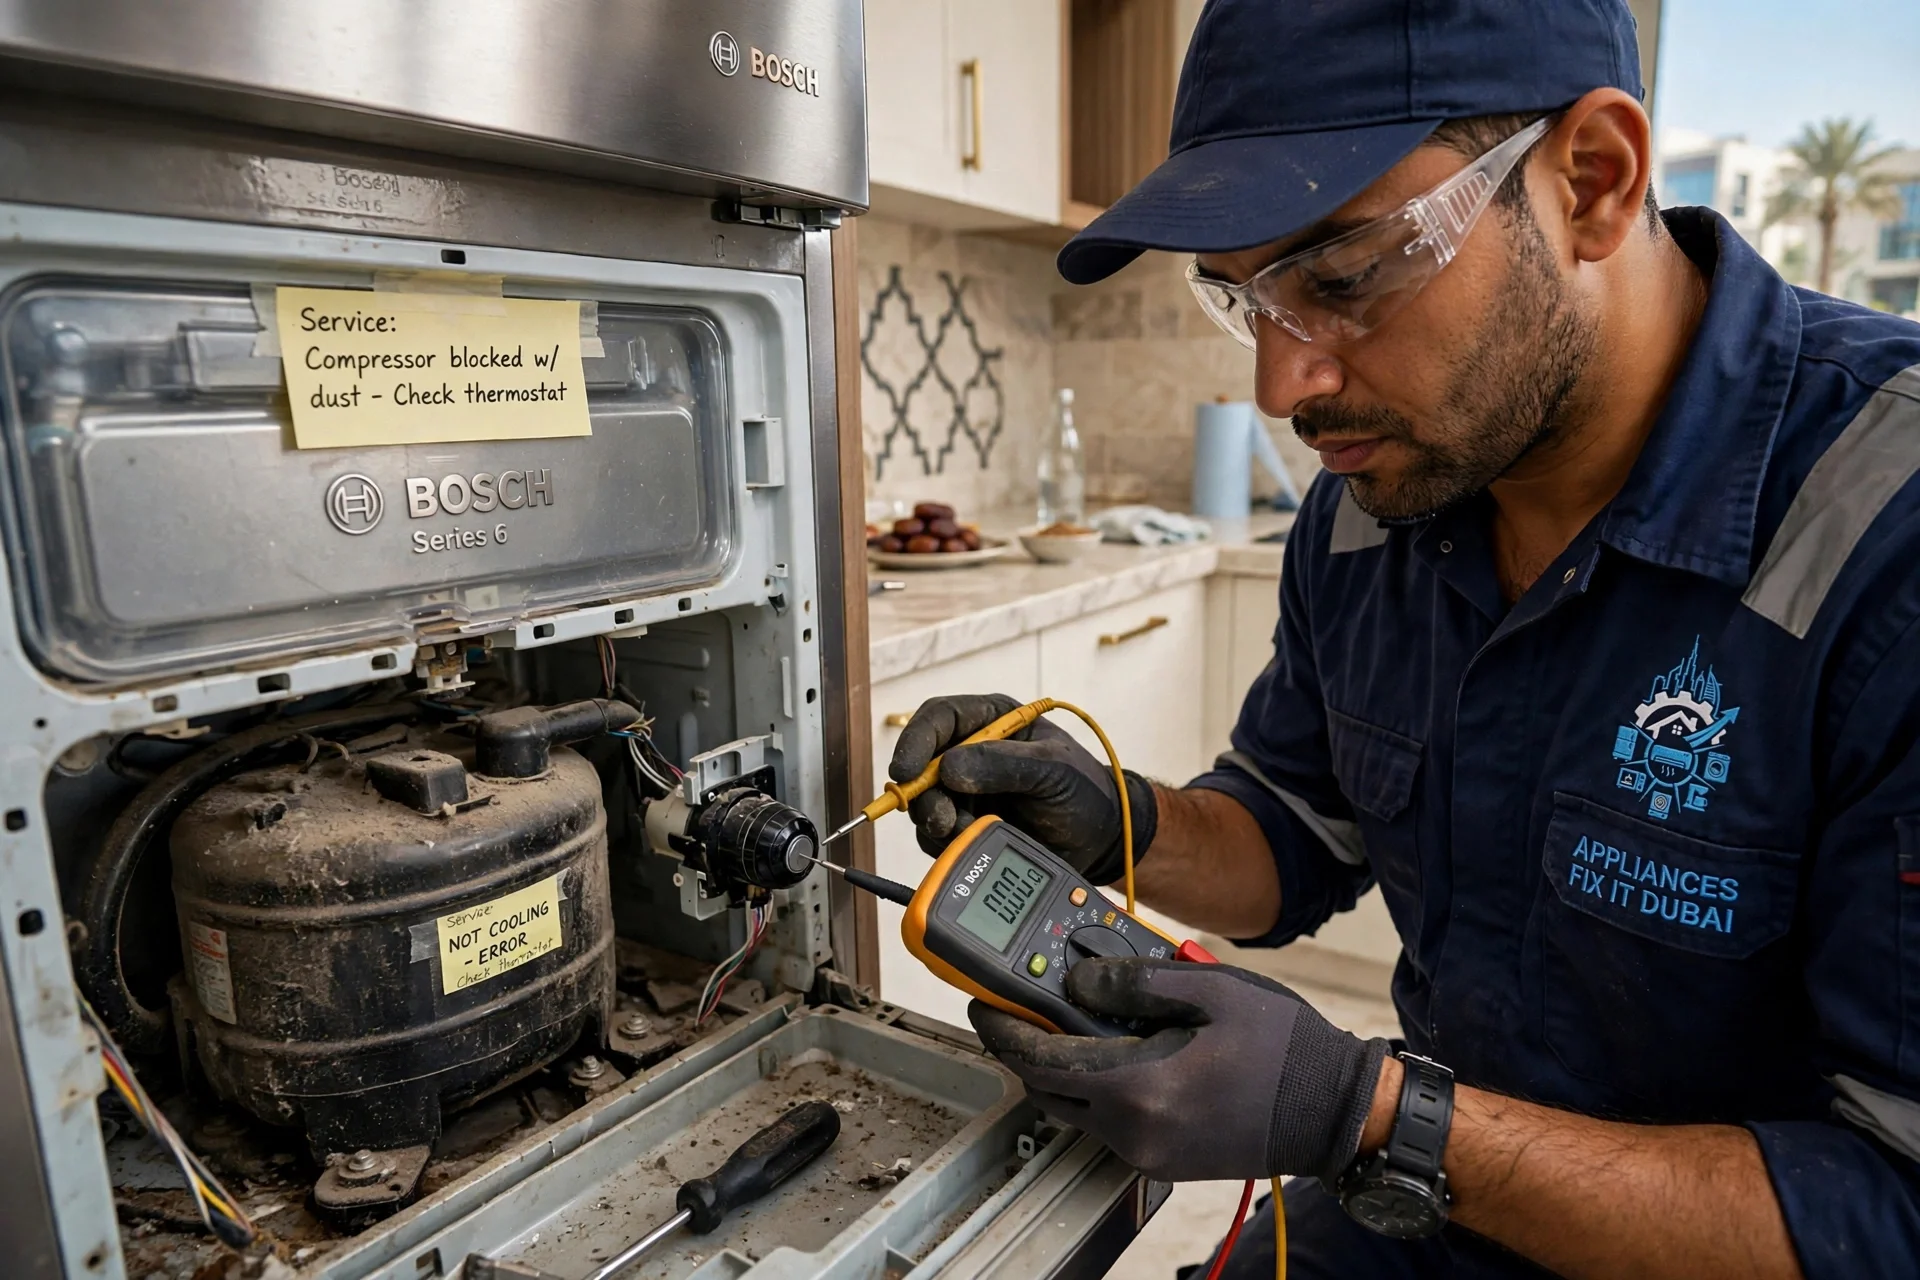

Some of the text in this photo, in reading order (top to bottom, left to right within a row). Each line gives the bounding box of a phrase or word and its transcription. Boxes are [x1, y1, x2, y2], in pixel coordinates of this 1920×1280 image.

[750, 46, 819, 97] BOSCH
[301, 307, 397, 332] Service:
[305, 344, 559, 378] Compressor blocked w/
[311, 384, 361, 407] dust
[394, 383, 455, 405] Check
[464, 382, 567, 402] thermostat
[405, 468, 554, 518] BOSCH
[412, 523, 508, 553] Series 6
[1572, 835, 1739, 901] APPLIANCES
[1568, 863, 1734, 933] FIX IT DUBAI
[449, 901, 549, 953] NOT COOLING
[479, 932, 528, 965] ERROR
